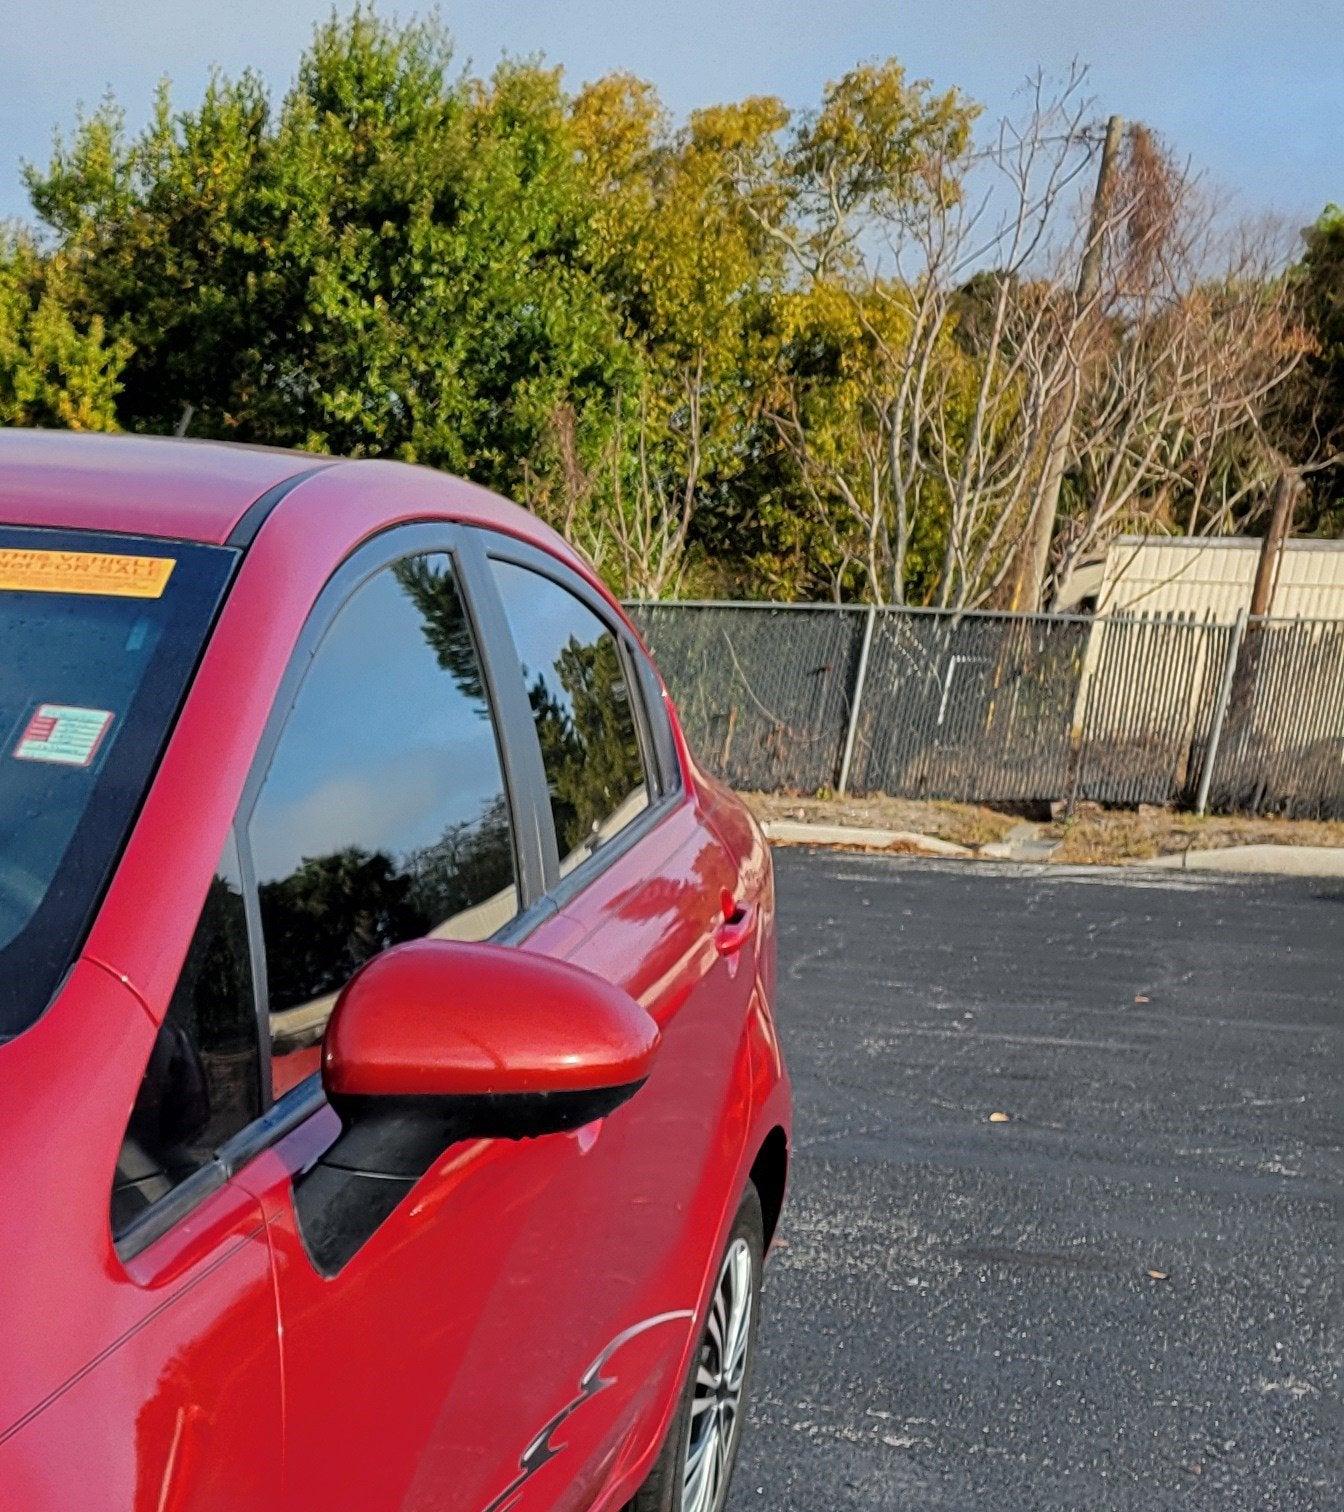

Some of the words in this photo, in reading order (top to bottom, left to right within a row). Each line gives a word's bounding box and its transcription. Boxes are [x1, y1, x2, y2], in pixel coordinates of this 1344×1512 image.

[0, 551, 50, 562] THIS
[59, 554, 161, 569] VEHICLE
[39, 561, 90, 573] FOR
[99, 564, 158, 577] SALE
